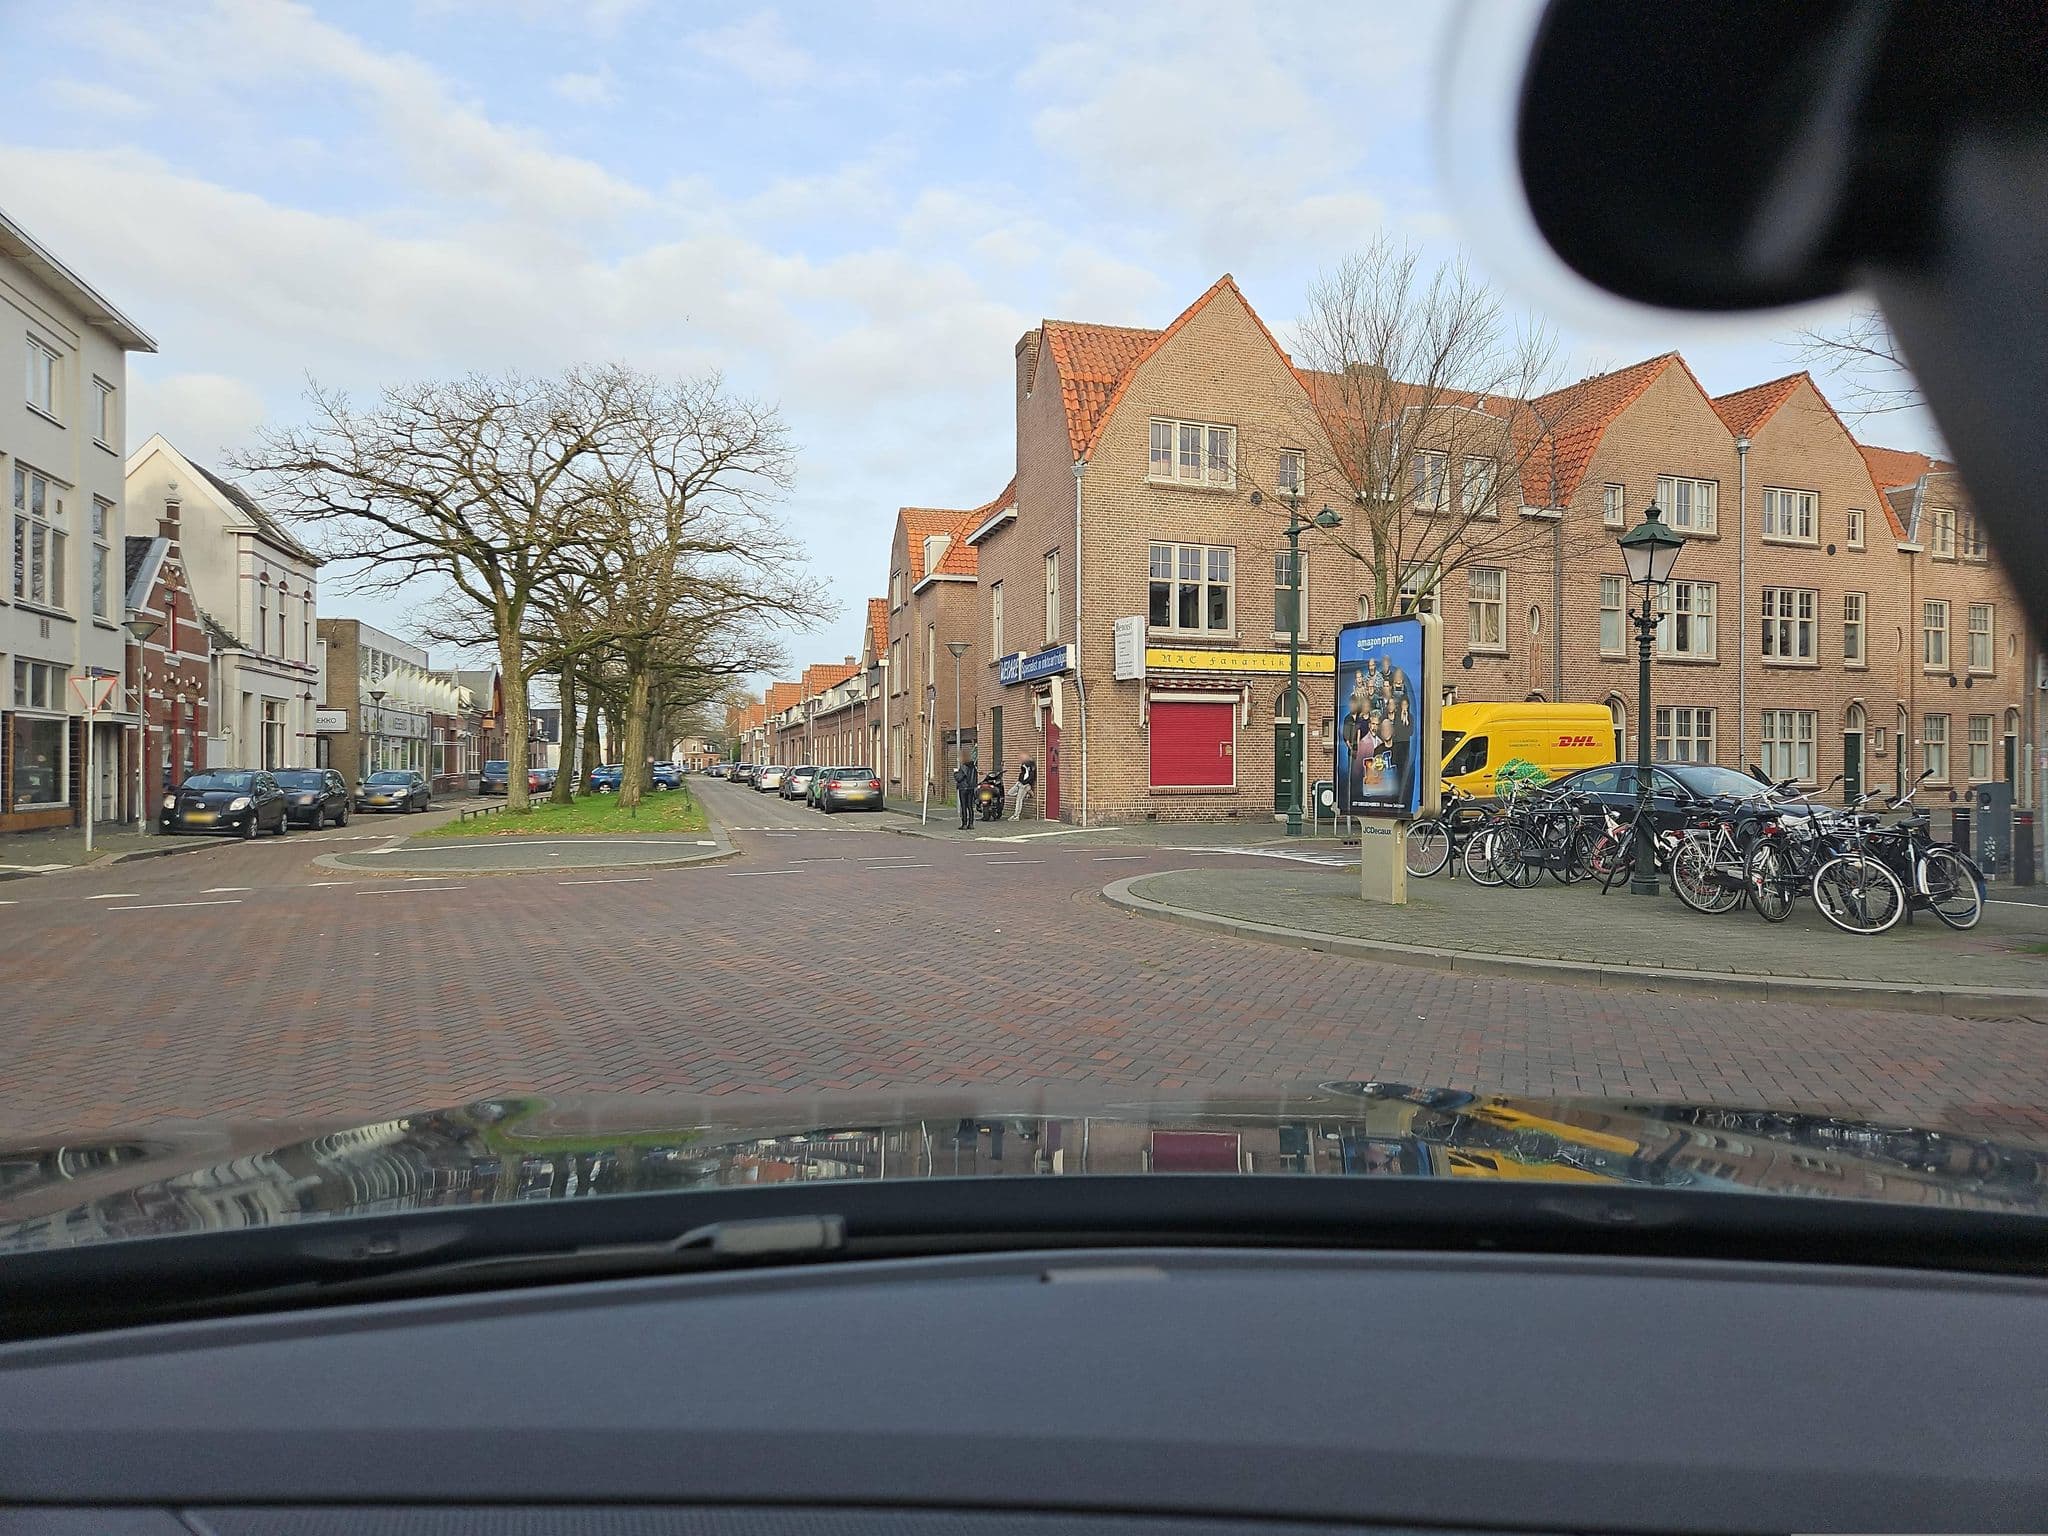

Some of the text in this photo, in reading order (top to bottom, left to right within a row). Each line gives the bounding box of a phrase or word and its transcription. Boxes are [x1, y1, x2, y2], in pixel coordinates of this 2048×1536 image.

[1357, 633, 1404, 648] amazon prime
[1161, 653, 1197, 665] NAC
[1558, 735, 1597, 748] DHL
[1362, 825, 1392, 836] JCDecaux
